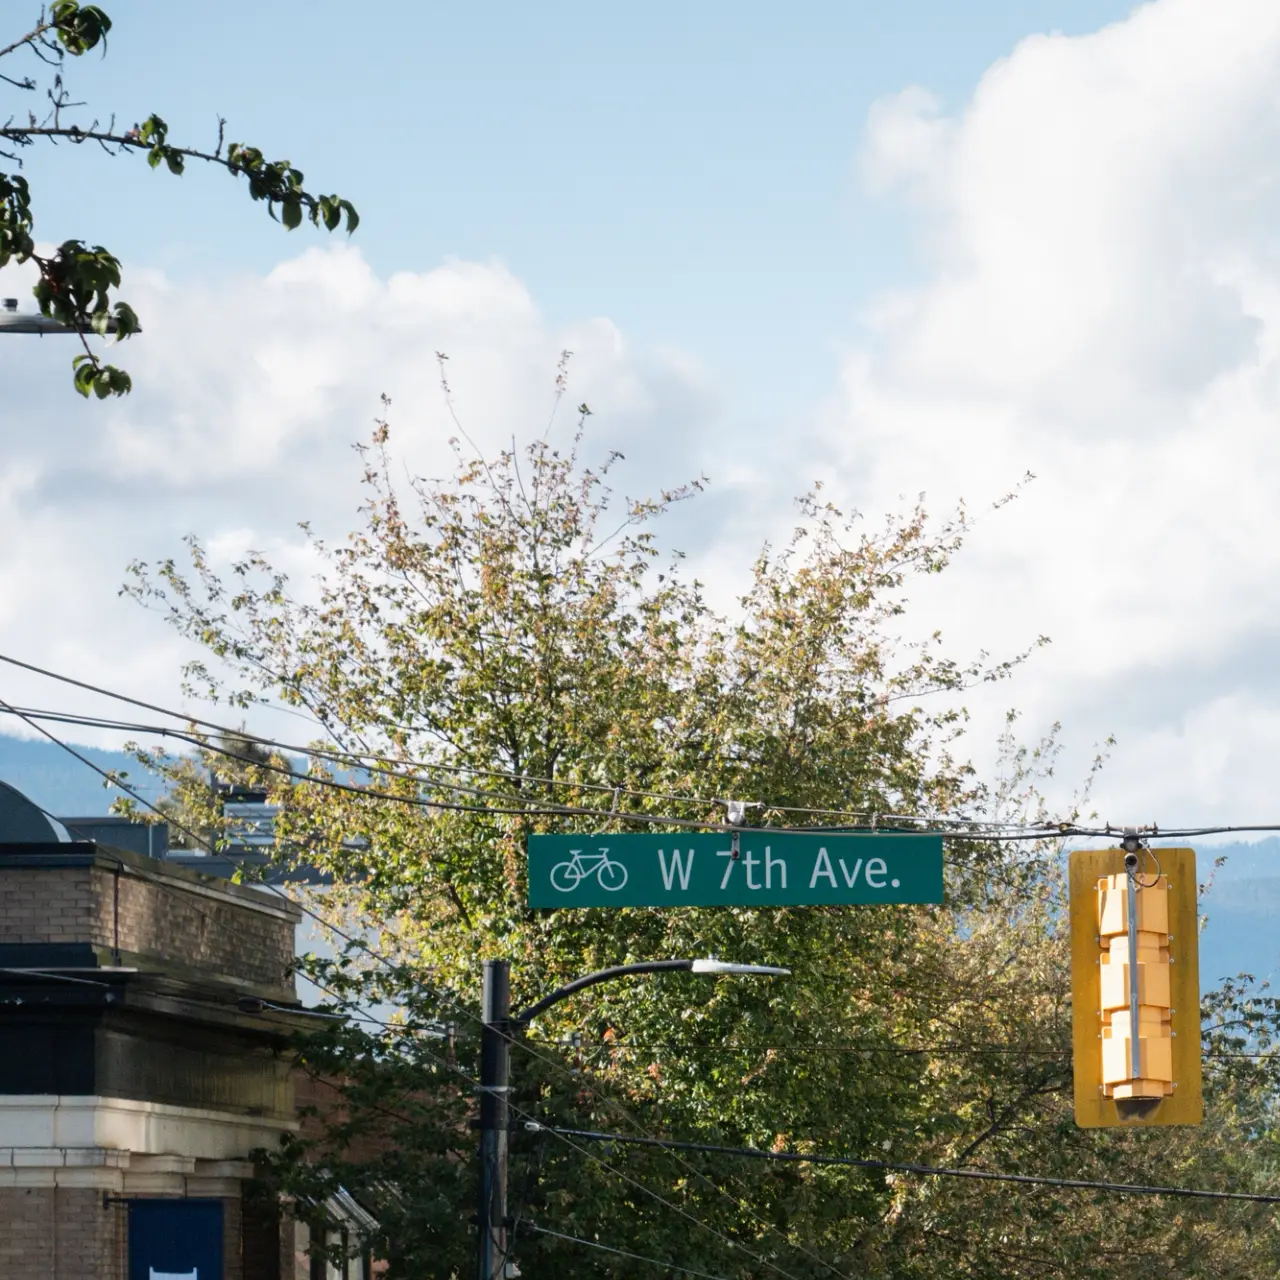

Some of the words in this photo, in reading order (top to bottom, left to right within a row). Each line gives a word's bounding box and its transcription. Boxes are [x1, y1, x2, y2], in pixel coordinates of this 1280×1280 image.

[657, 848, 695, 891] W
[716, 846, 787, 890] 7th
[809, 847, 901, 889] Ave.
